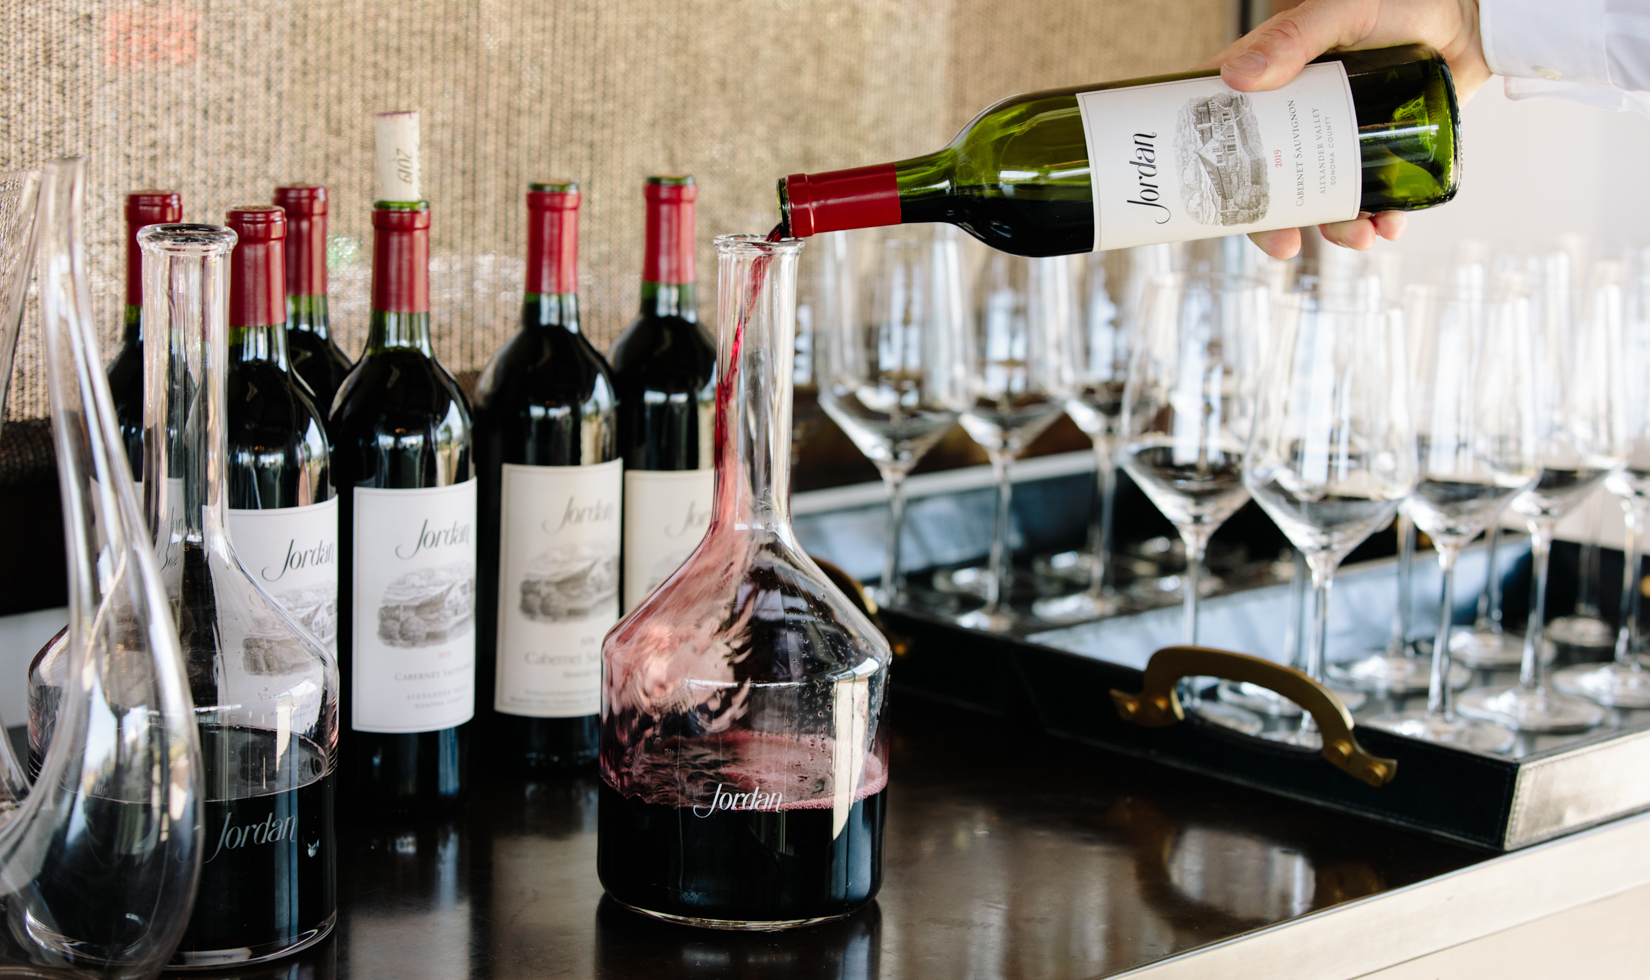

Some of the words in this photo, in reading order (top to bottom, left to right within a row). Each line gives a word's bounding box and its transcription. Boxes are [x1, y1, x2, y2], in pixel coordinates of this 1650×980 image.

[1287, 100, 1303, 159] SAUVIGNON
[1312, 107, 1324, 141] VALLEY
[1324, 115, 1334, 149] COUNTY
[396, 148, 412, 184] 2019
[1126, 131, 1171, 224] Jordan
[1274, 149, 1282, 168] 2019
[1317, 142, 1326, 195] ALEXANDER
[1295, 161, 1304, 207] CABERNET
[261, 538, 334, 583] Jordan
[395, 518, 470, 560] Jordan
[693, 783, 782, 819] Jordan
[203, 812, 296, 863] Jordan
